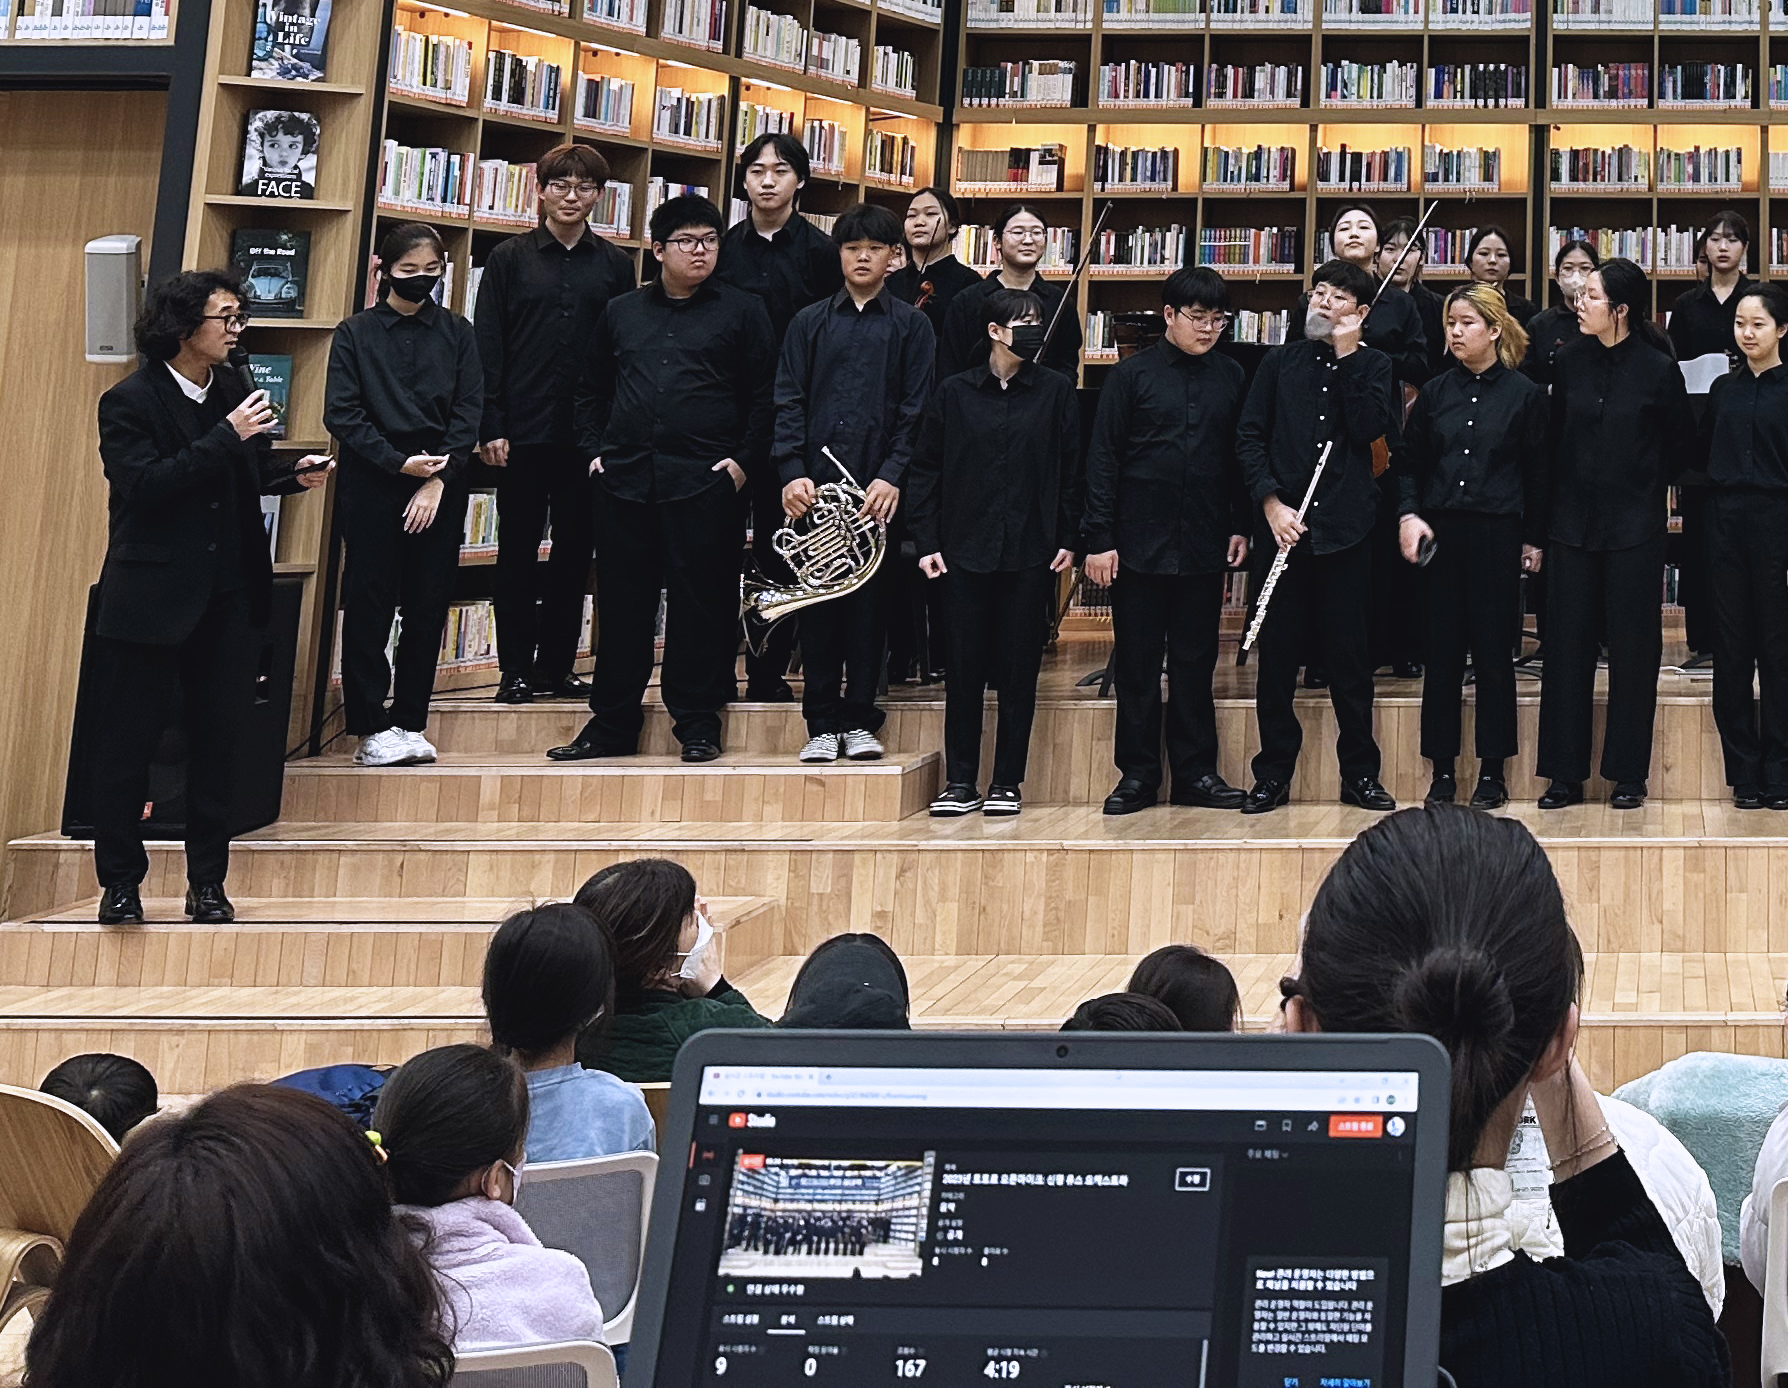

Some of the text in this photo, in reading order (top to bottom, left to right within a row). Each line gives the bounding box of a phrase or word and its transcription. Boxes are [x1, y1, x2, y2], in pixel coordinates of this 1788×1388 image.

[271, 11, 321, 26] Vintage
[285, 22, 298, 32] in
[277, 32, 309, 45] Life
[257, 180, 301, 197] FACE
[263, 247, 275, 255] the
[277, 248, 295, 256] Road
[972, 1173, 999, 1185] 토토로
[715, 1357, 727, 1375] 9
[804, 1358, 817, 1376] 0
[896, 1359, 927, 1377] 167
[983, 1360, 1020, 1379] 4:19
